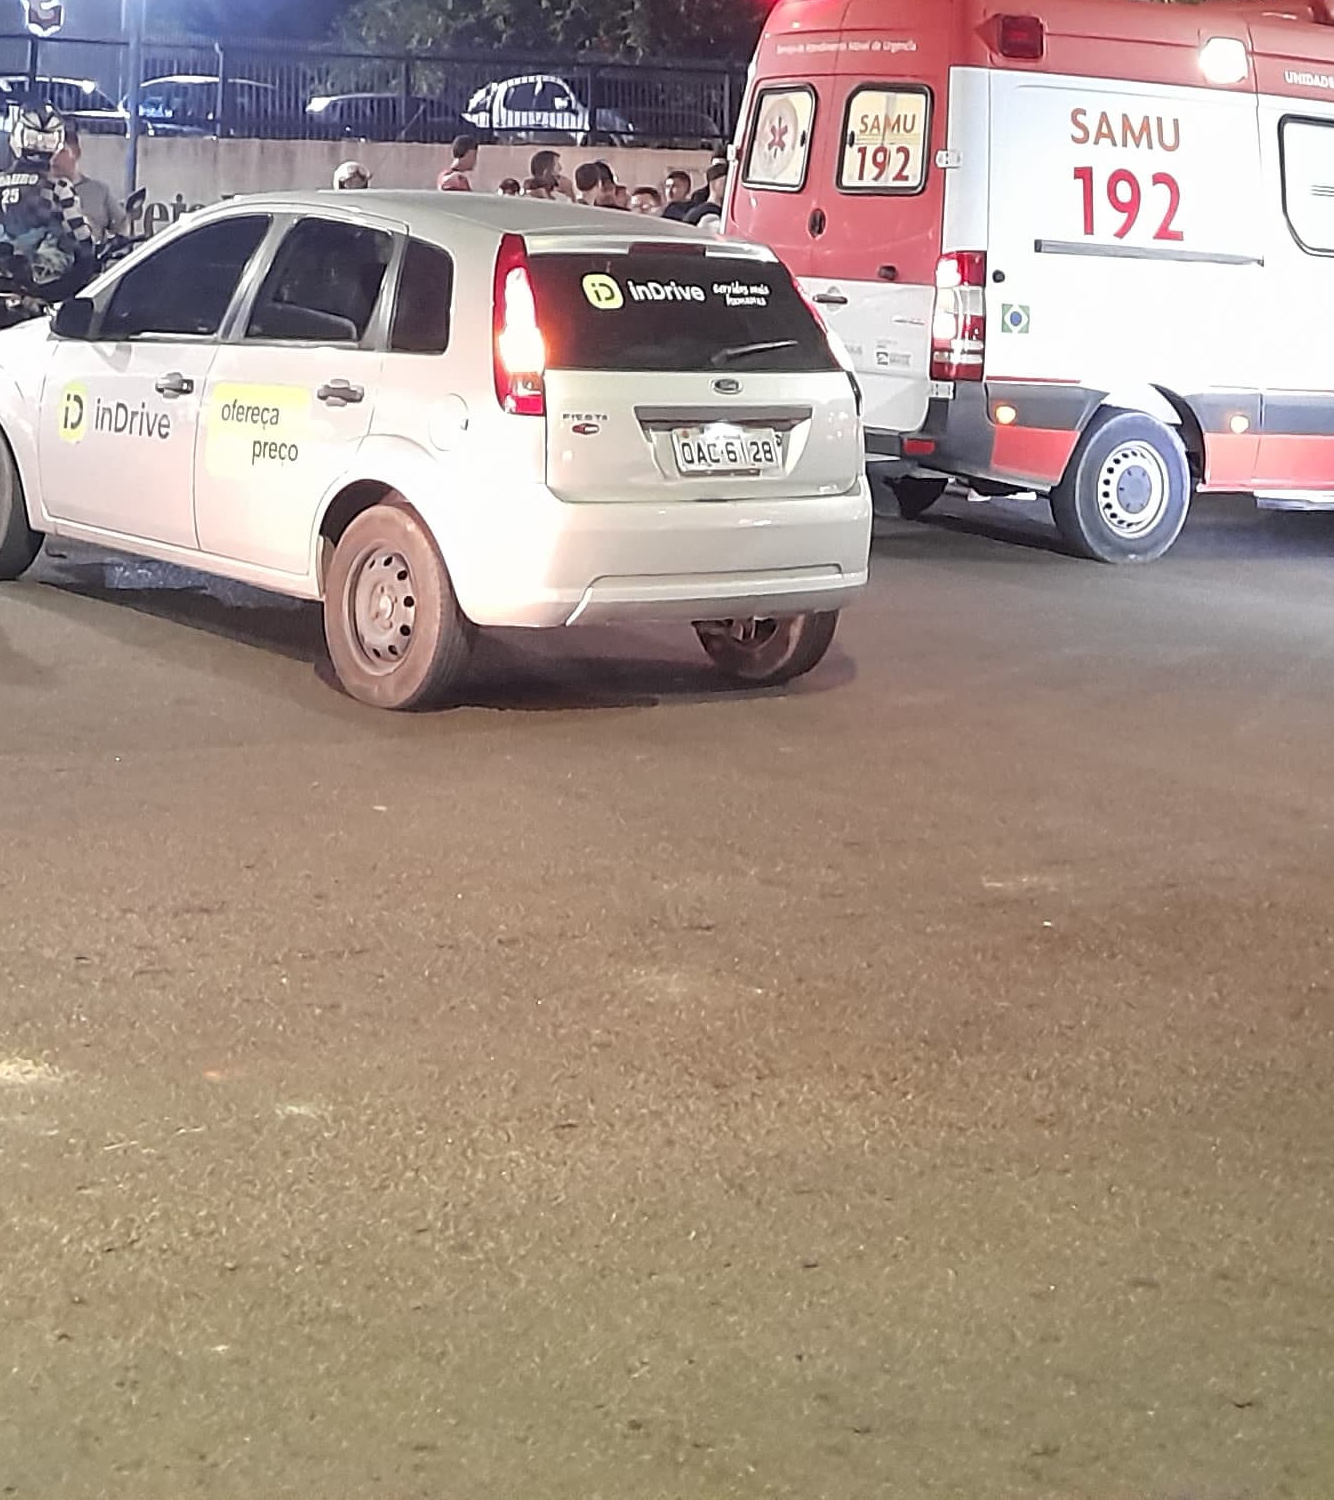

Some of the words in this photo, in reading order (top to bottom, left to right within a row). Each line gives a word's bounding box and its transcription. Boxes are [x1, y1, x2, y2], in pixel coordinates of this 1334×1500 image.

[1284, 69, 1334, 89] UNIDADE
[859, 114, 916, 135] SAMU
[1070, 107, 1180, 152] SAMU
[857, 146, 911, 182] 192
[1, 187, 20, 204] 25
[1073, 166, 1185, 242] 192
[627, 280, 706, 302] inDrive
[94, 398, 171, 440] inDrive
[221, 399, 280, 431] ofereça
[562, 413, 608, 422] FIESTA
